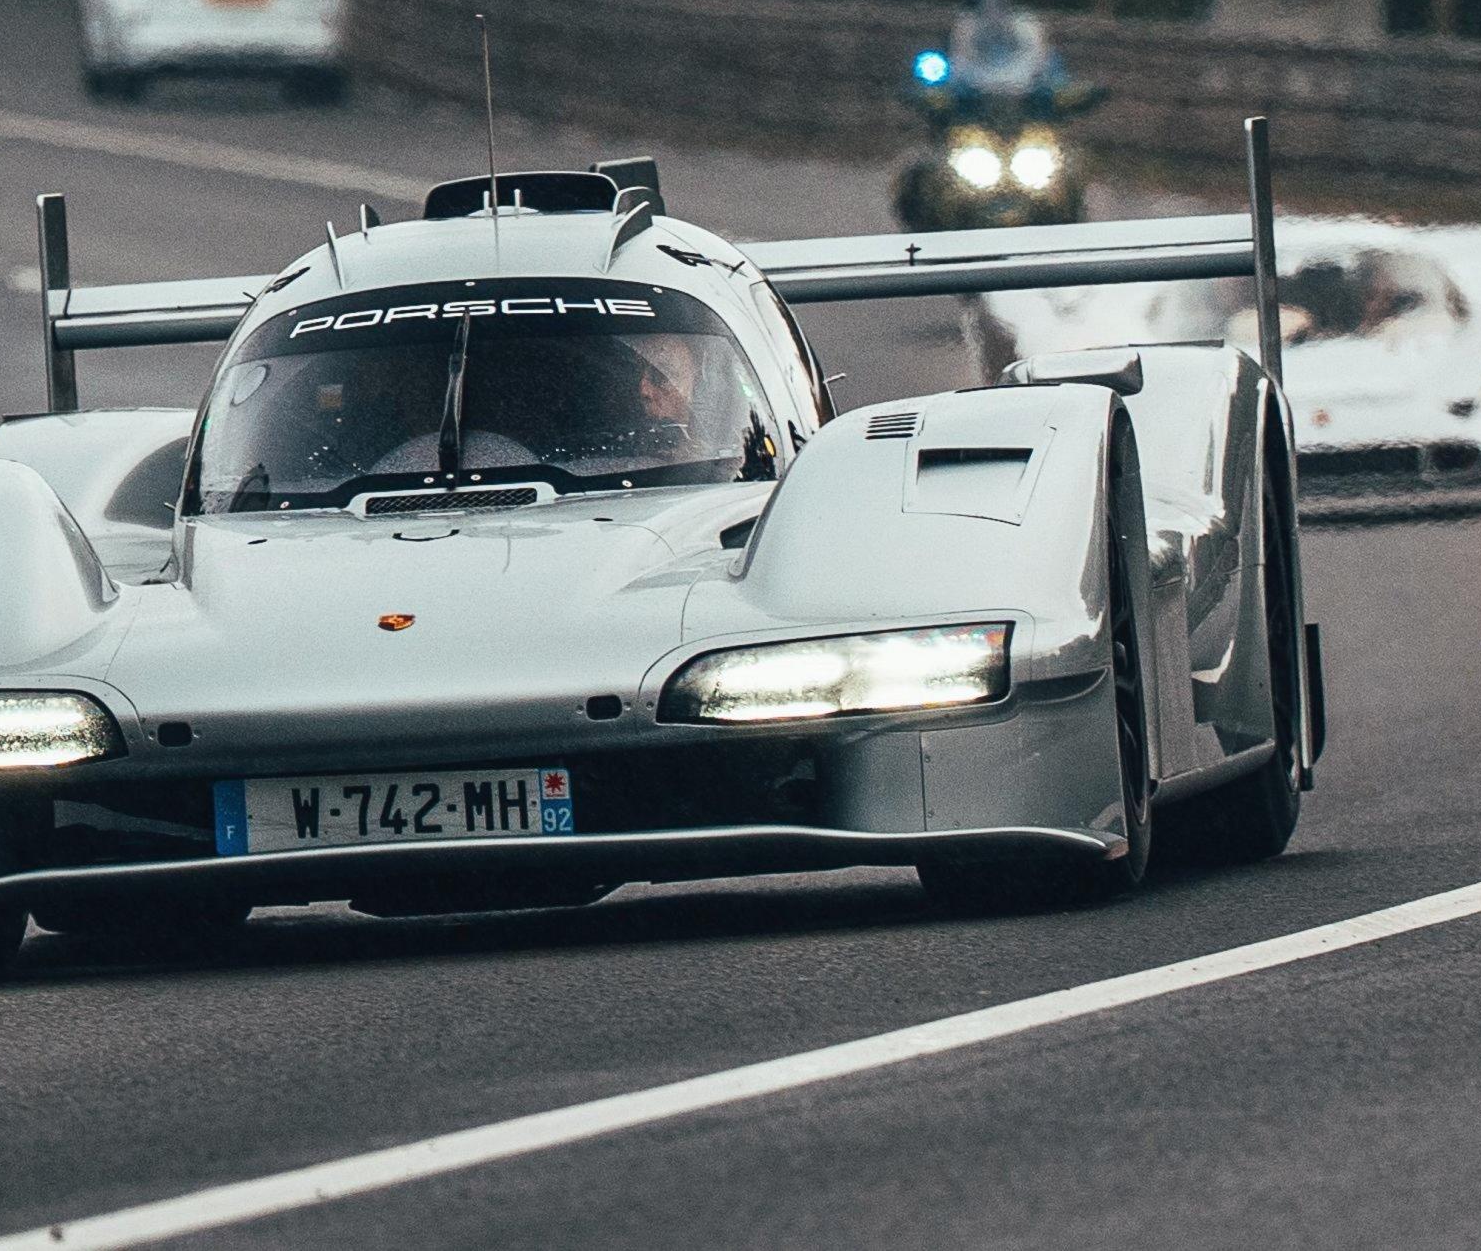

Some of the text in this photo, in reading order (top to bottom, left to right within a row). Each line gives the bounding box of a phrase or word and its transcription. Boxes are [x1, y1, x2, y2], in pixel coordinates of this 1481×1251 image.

[289, 298, 656, 338] PORSCHE
[291, 780, 529, 838] W-742-MH
[544, 808, 572, 831] 92
[226, 825, 236, 840] F
